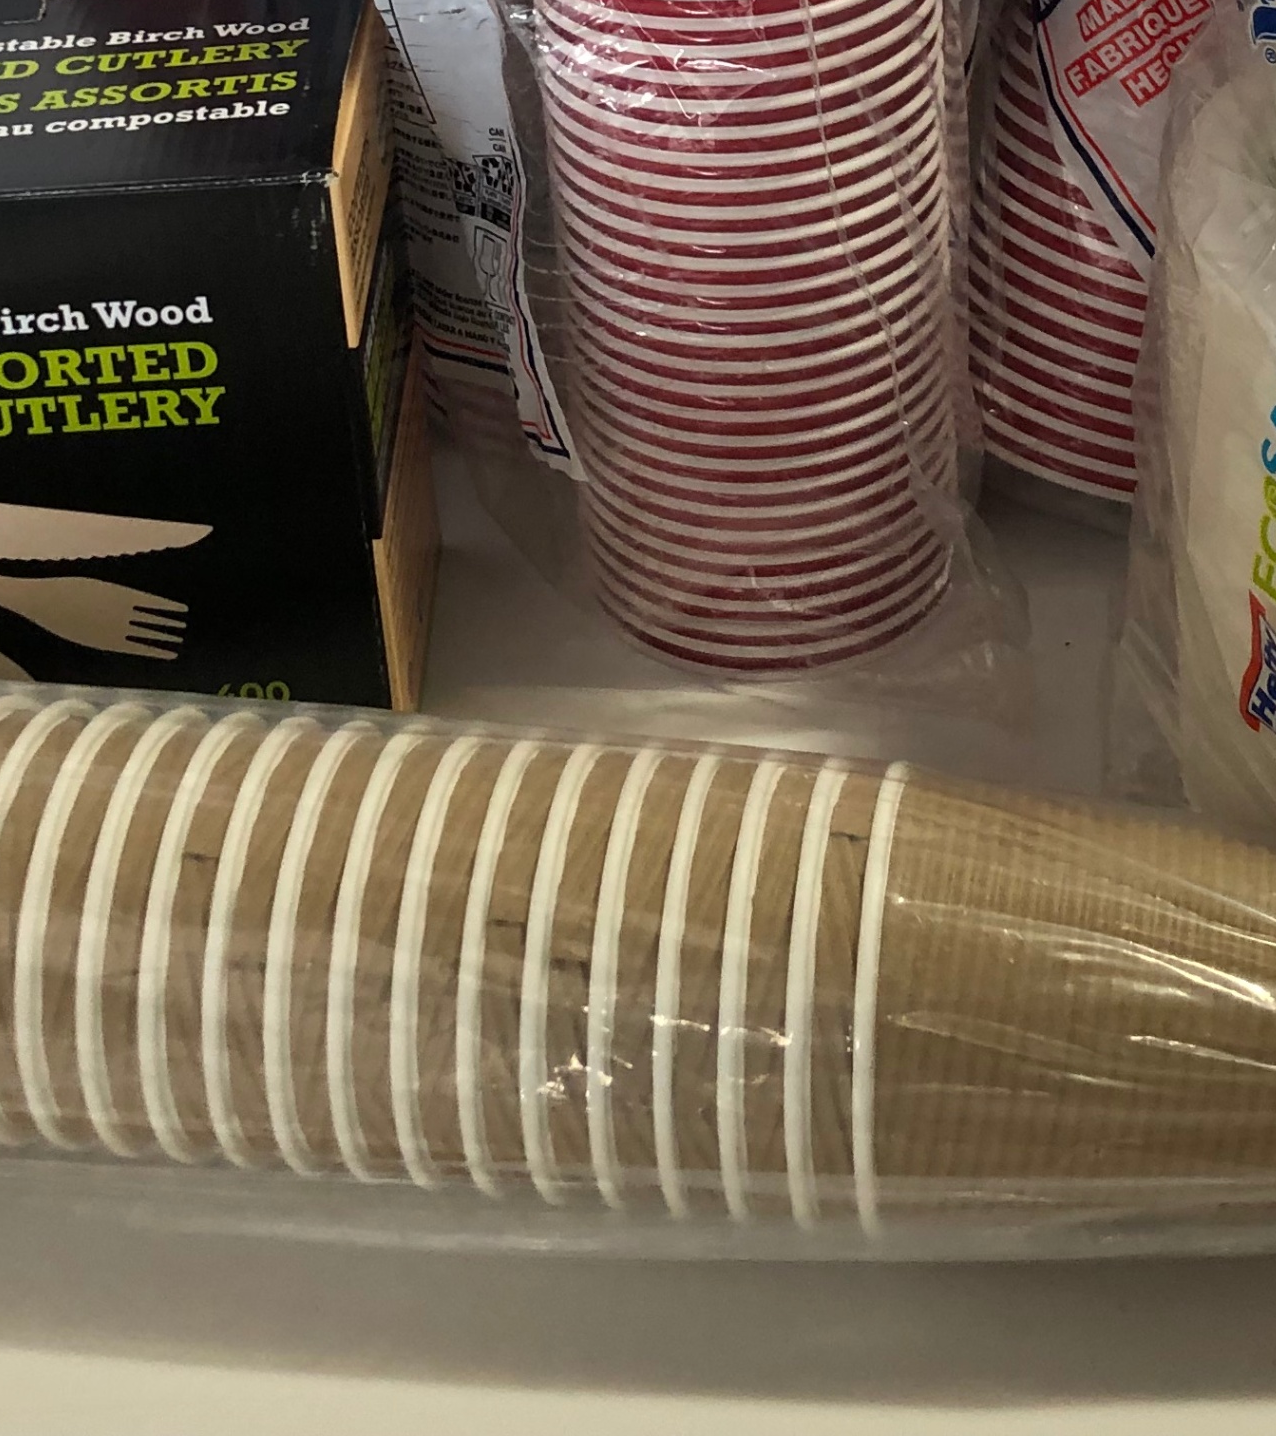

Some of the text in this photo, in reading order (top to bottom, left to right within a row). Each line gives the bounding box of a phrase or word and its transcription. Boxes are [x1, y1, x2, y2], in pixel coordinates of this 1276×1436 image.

[104, 26, 205, 46] Birch
[213, 17, 311, 37] Wood
[54, 38, 310, 75] CUTLERY
[29, 70, 298, 112] ASSORTIS
[44, 100, 291, 134] compostable
[91, 296, 214, 329] Wood
